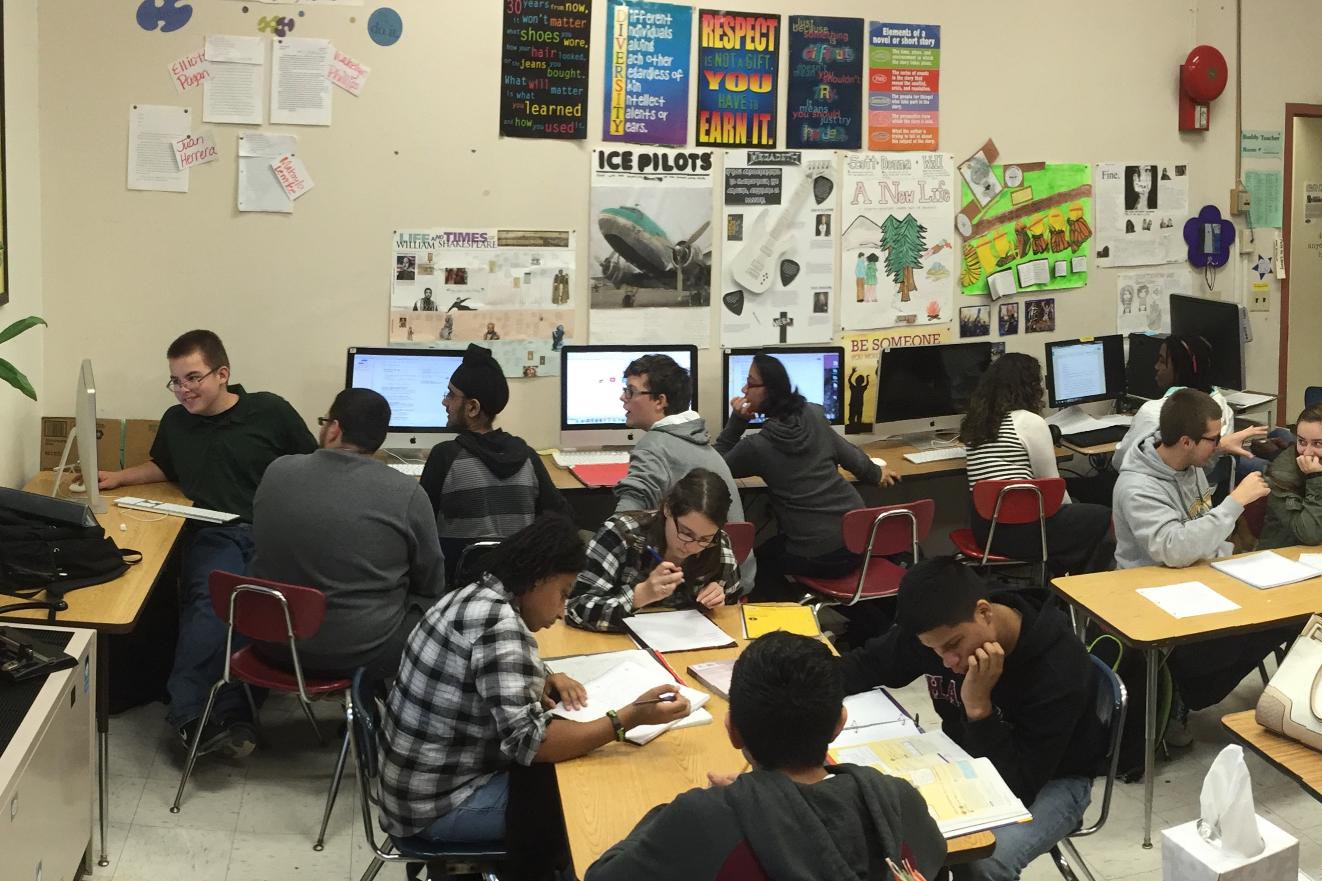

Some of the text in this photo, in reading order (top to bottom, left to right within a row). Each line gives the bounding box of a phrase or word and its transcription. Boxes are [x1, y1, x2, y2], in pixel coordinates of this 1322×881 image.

[507, 0, 522, 14] 30
[523, 0, 550, 9] years
[566, 3, 589, 14] now,
[522, 14, 549, 25] won't
[550, 18, 587, 28] matter
[520, 27, 560, 43] shoes
[702, 13, 778, 52] RESPECT
[883, 28, 912, 37] Elements
[913, 29, 920, 37] of
[563, 38, 589, 48] wore.
[873, 36, 891, 45] novel
[901, 37, 918, 46] short
[919, 38, 936, 48] story
[531, 47, 557, 58] hair
[520, 60, 547, 70] jeans
[645, 54, 673, 67] other
[715, 52, 735, 67] NOT
[547, 68, 585, 80] bought.
[671, 69, 685, 82] of
[504, 75, 583, 96] What will matter
[704, 70, 772, 93] YOU
[516, 91, 535, 99] what
[718, 94, 749, 109] HAVE
[525, 101, 582, 118] learned
[793, 110, 841, 120] you should
[800, 104, 829, 114] means
[515, 117, 533, 128] how
[545, 121, 576, 134] used
[820, 115, 852, 127] just try
[699, 111, 774, 145] EARN IT.
[176, 136, 204, 152] Juan
[1260, 134, 1281, 143] Teacher
[181, 146, 218, 168] Herrera
[598, 150, 712, 172] ICE PILOTS
[1101, 170, 1121, 181] Fine.
[851, 181, 873, 205] A
[399, 232, 430, 243] LIFE
[444, 231, 488, 243] TIMES
[396, 240, 497, 250] WILLIAM SHAKESPEARE
[851, 333, 942, 352] BE SOMEONE
